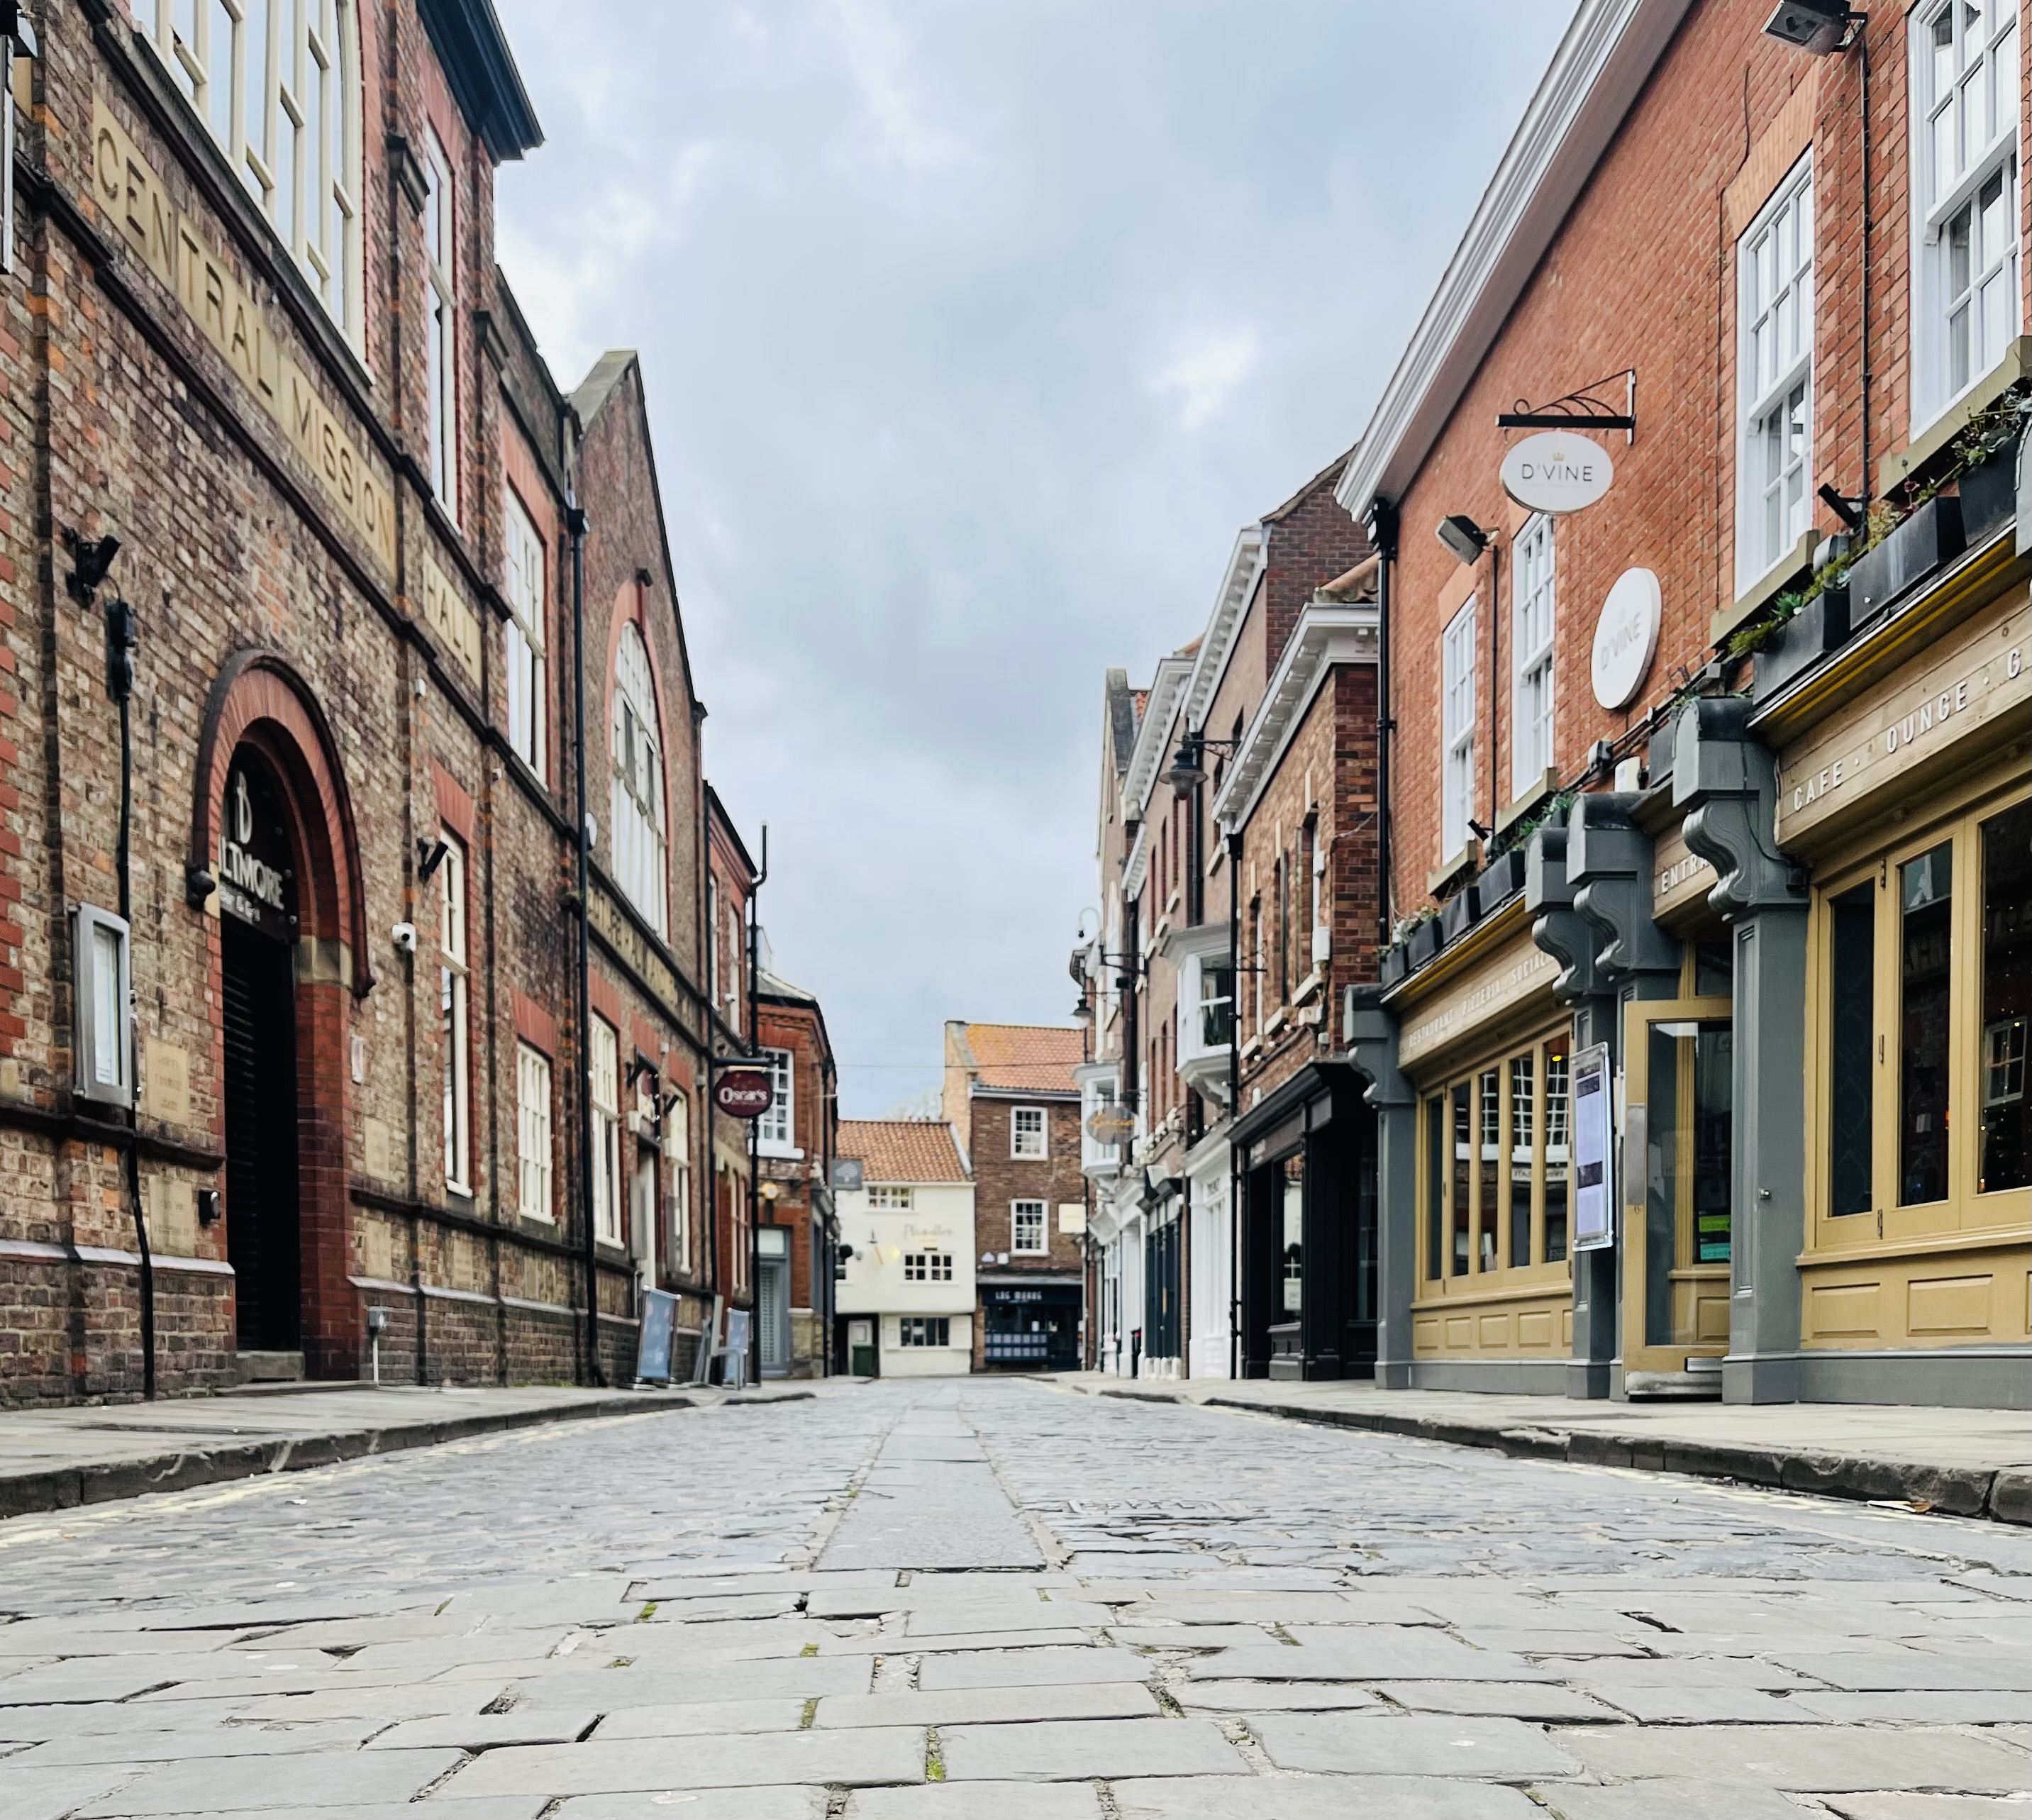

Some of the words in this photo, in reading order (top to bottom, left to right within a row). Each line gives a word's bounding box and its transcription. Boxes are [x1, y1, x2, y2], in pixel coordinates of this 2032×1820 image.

[97, 126, 273, 398] CENTRAL
[292, 376, 394, 559] MISSION
[427, 564, 472, 665] HALL
[1521, 462, 1593, 482] D'VINE
[1600, 610, 1642, 671] D'VINE
[1793, 760, 1843, 811] CAFE
[218, 834, 284, 912] ILTMORE
[1408, 1008, 1454, 1048] RESTAURANT
[1462, 980, 1501, 1016] PIZZERIA
[1511, 951, 1547, 985] SOCIAL
